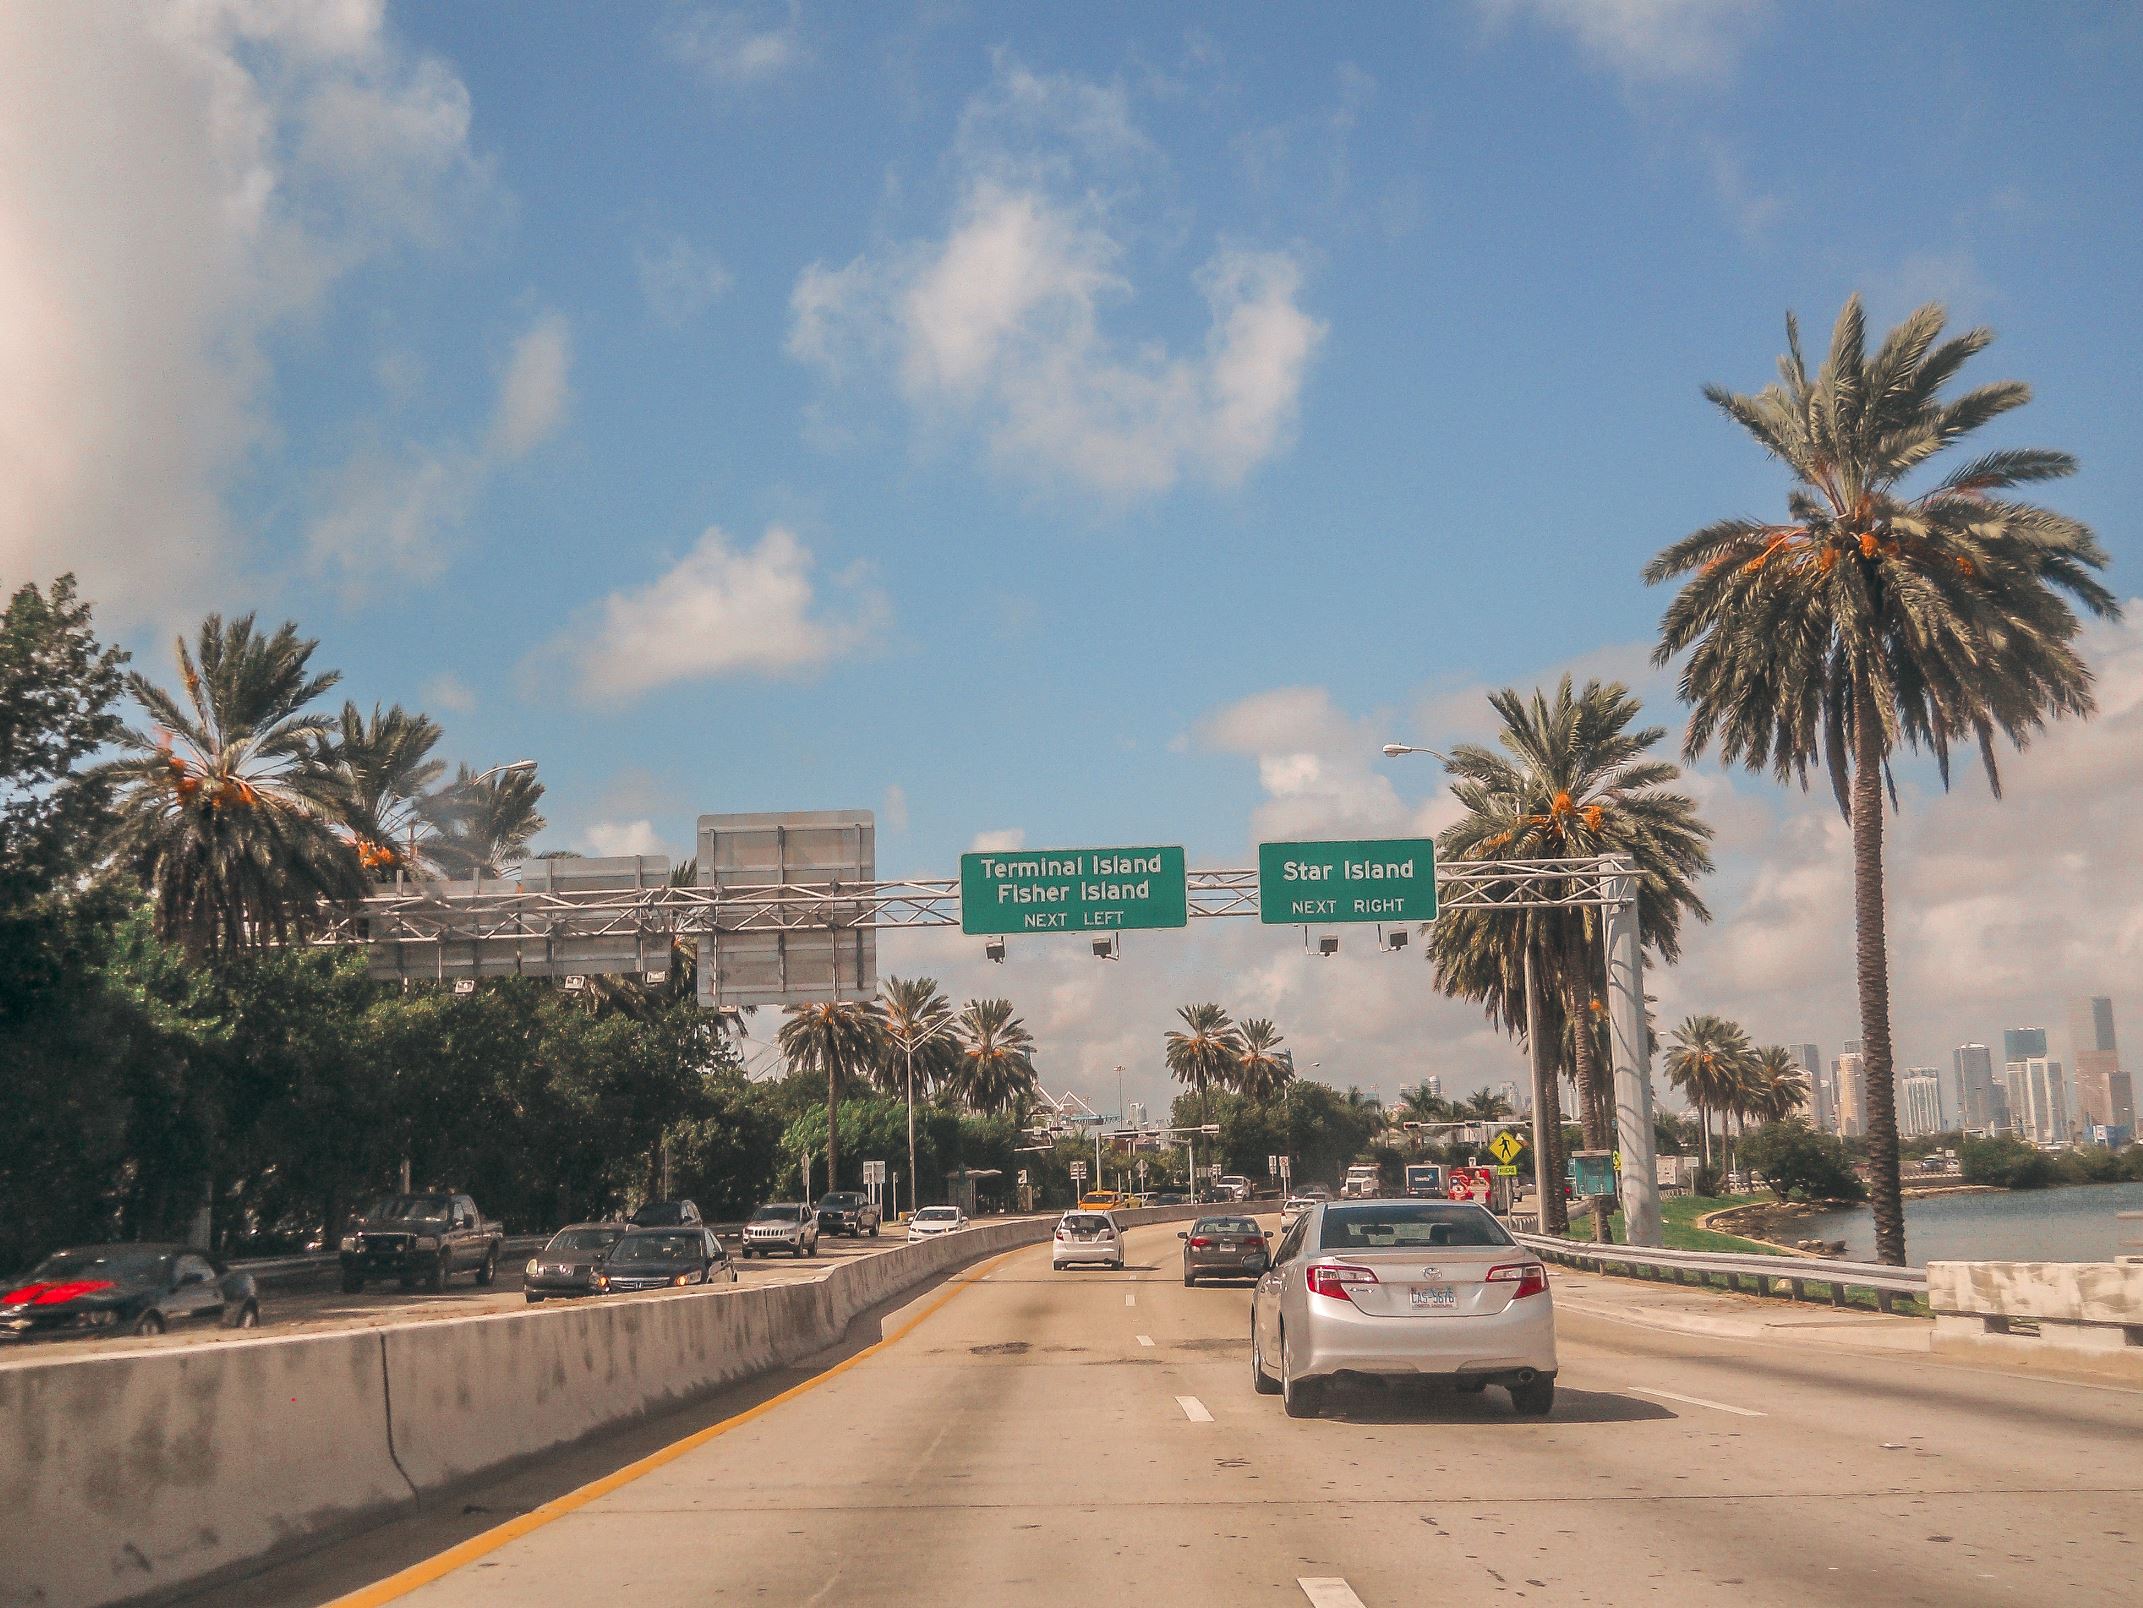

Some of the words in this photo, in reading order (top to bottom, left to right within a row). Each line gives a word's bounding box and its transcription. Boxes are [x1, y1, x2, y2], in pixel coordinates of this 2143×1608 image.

[980, 855, 1083, 878] Terminal
[1093, 853, 1161, 875] Island
[1283, 861, 1333, 881] Star
[1344, 859, 1414, 880] Island
[998, 883, 1070, 904] Fisher
[1081, 880, 1149, 900] Island
[1292, 900, 1337, 914] NEXT
[1353, 898, 1405, 913] RIGHT
[1024, 912, 1067, 928] NEXT
[1084, 910, 1124, 926] LEFT
